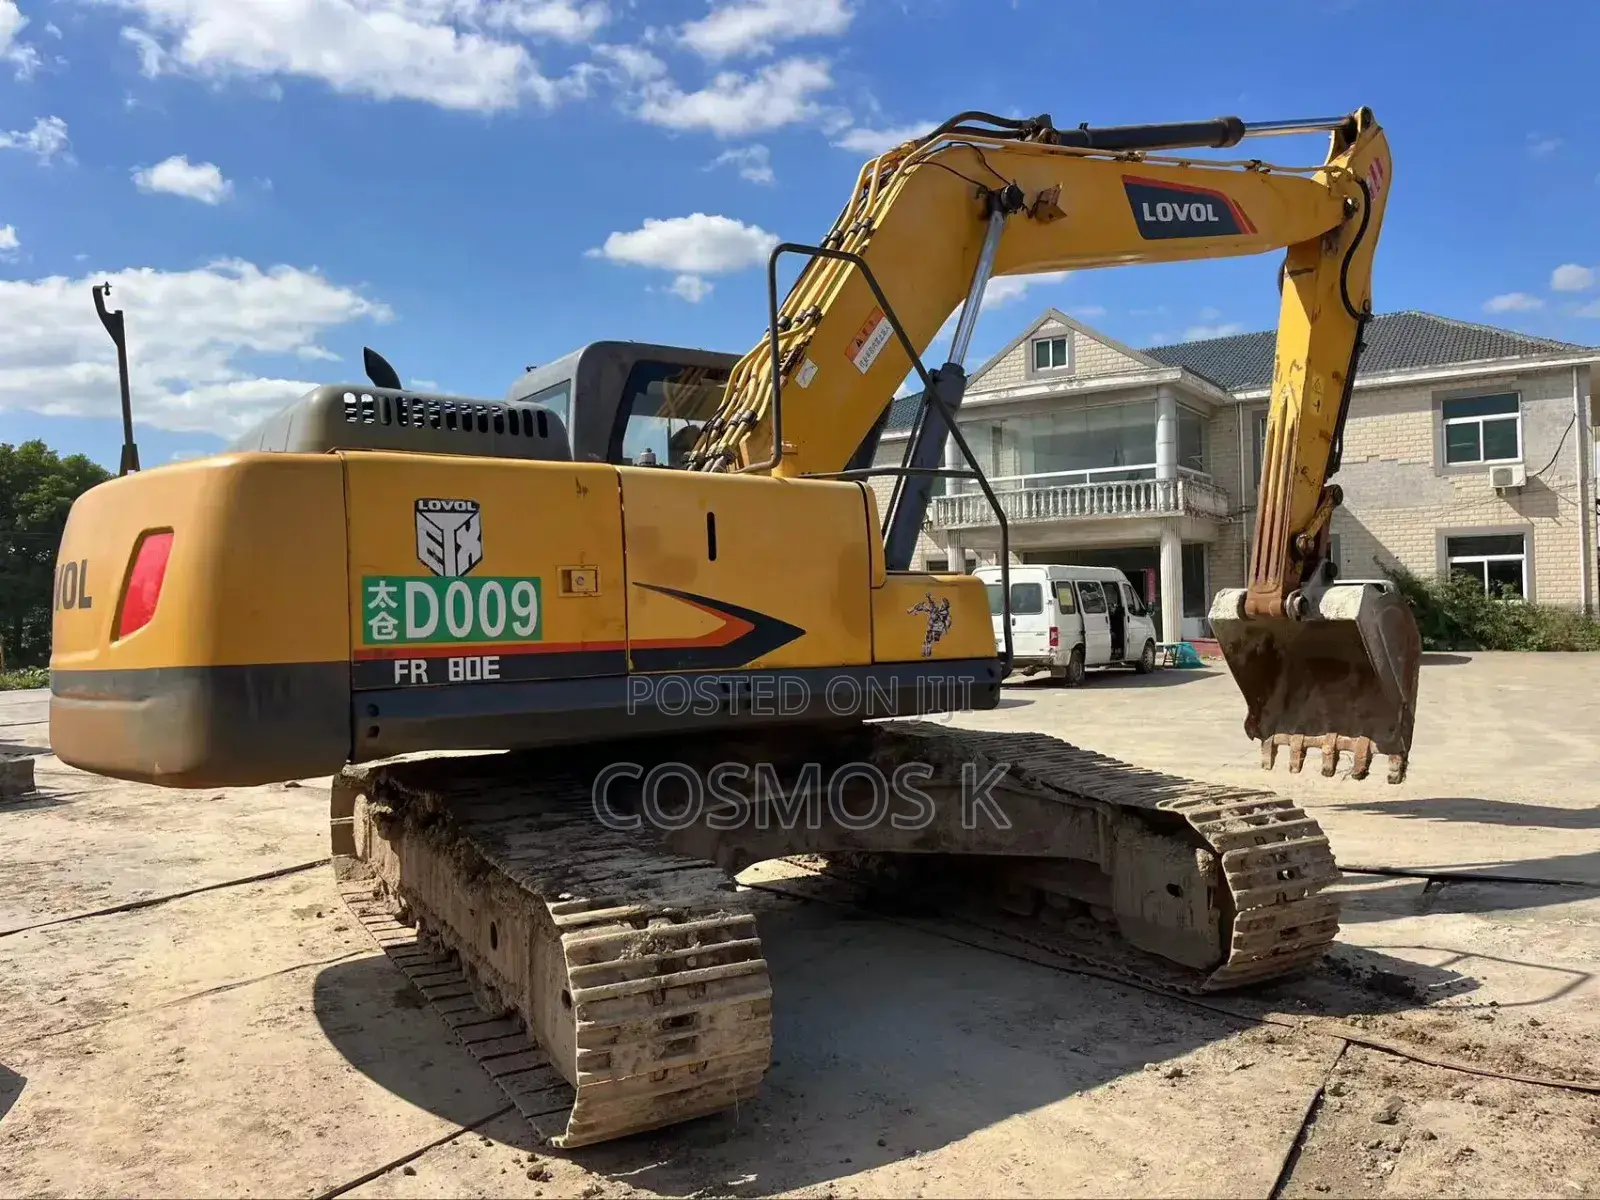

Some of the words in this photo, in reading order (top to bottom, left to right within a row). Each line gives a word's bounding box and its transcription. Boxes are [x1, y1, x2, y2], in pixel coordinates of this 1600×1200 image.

[1142, 202, 1219, 222] LOVOL
[418, 500, 477, 511] LOVOL
[367, 580, 398, 640] 太仓
[405, 580, 538, 639] D009
[394, 659, 429, 684] FR
[448, 656, 501, 682] 80E
